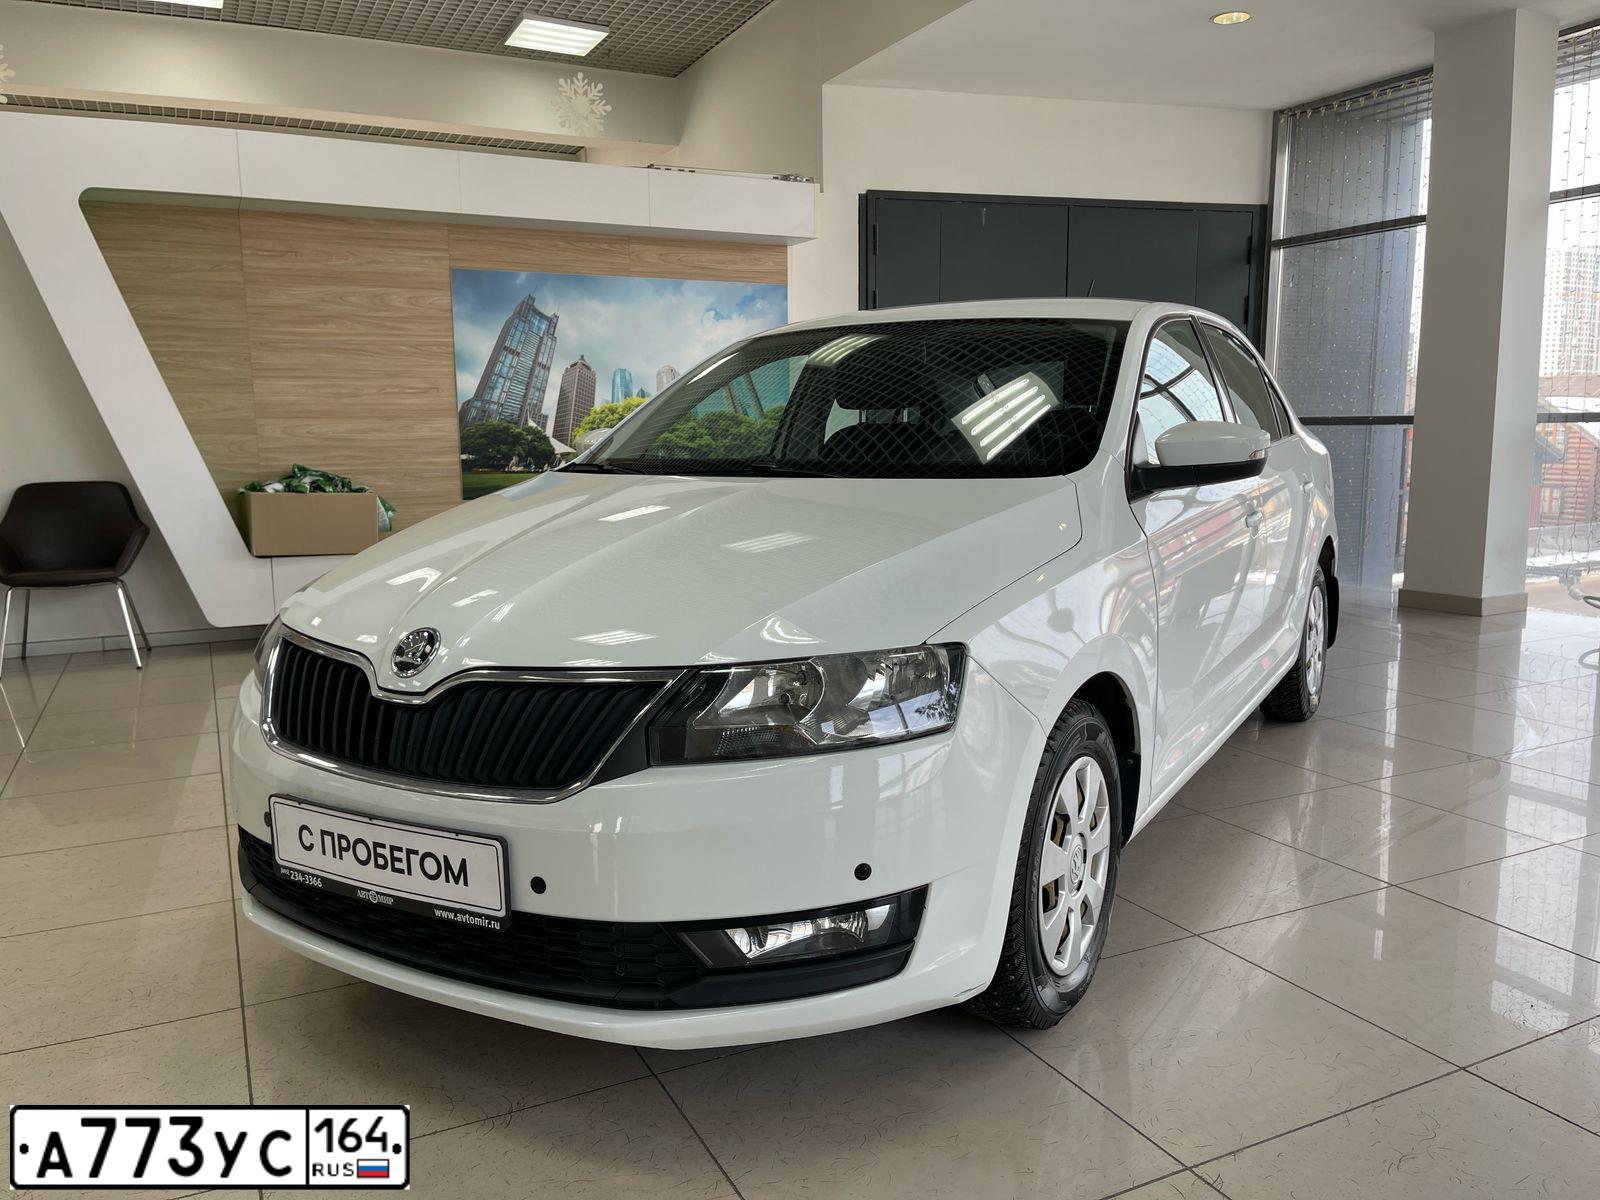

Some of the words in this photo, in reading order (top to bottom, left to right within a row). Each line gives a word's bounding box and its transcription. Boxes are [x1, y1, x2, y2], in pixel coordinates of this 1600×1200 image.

[298, 824, 314, 852] С
[320, 828, 469, 887] ПРОБЕГОМ
[290, 870, 323, 888] 234-3366
[434, 908, 500, 930] www.avtomir.ru
